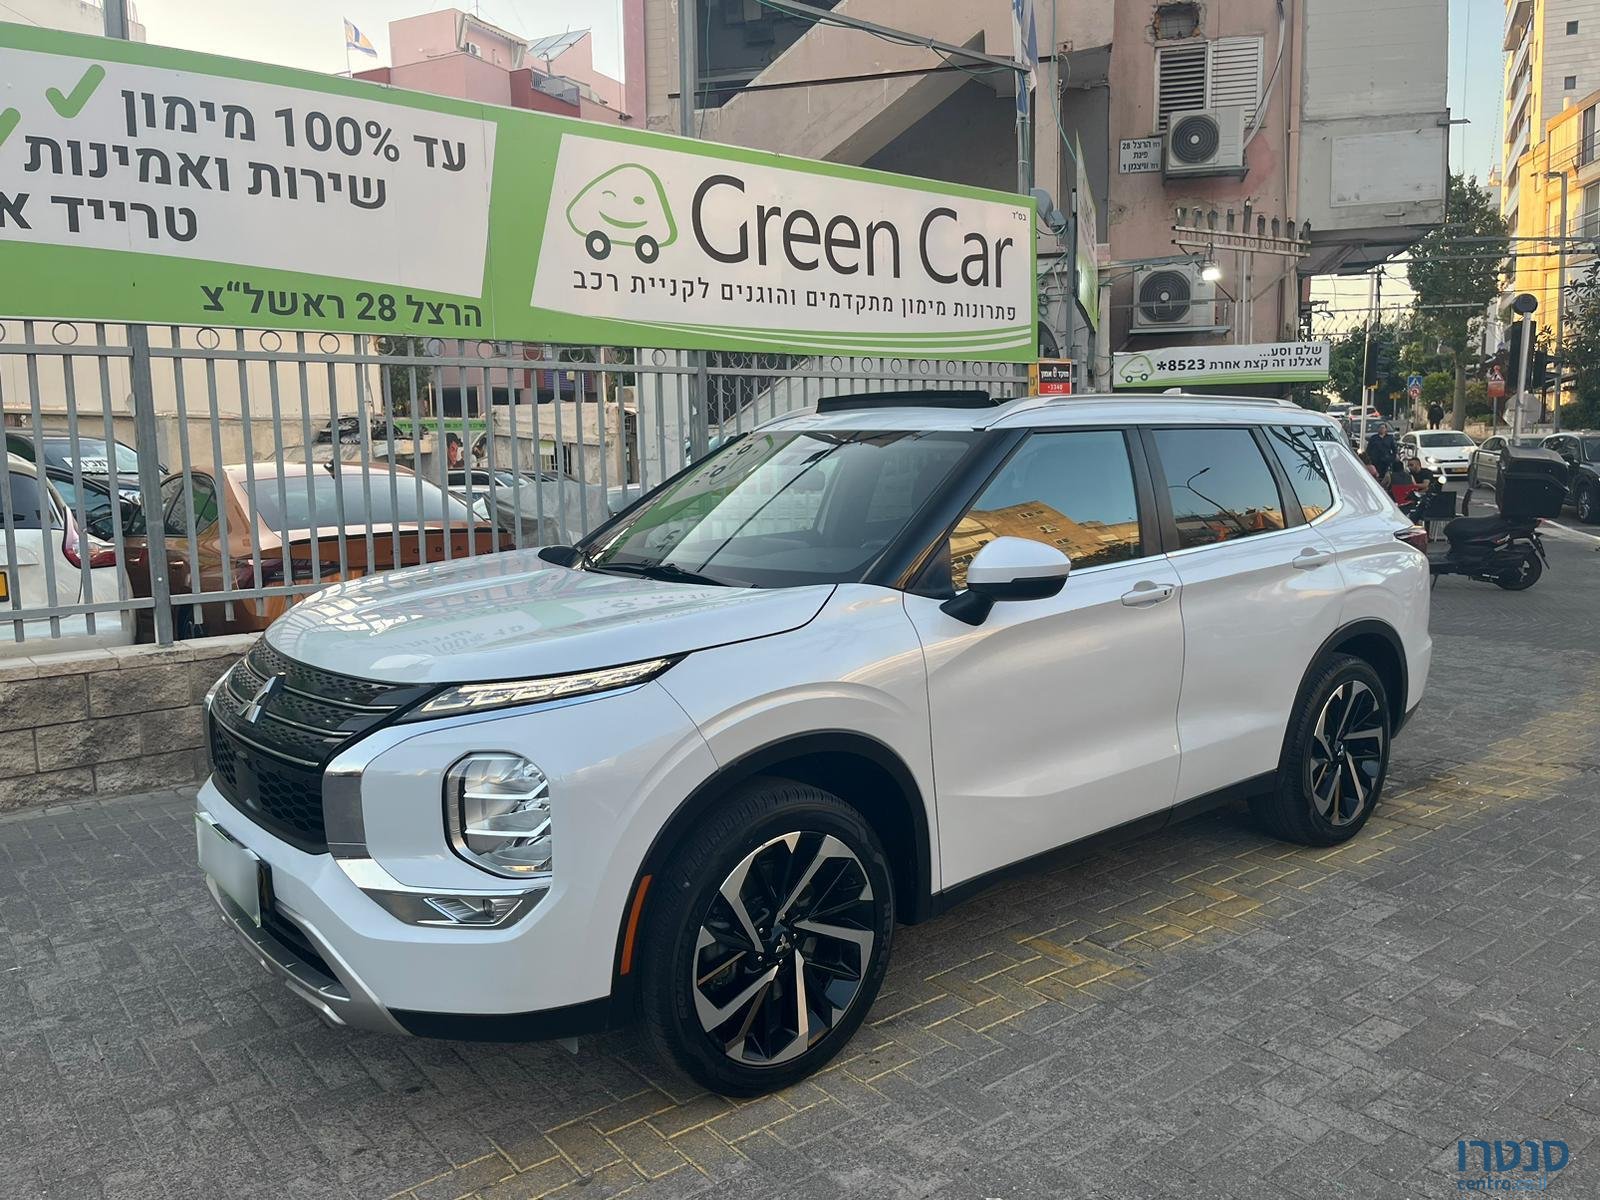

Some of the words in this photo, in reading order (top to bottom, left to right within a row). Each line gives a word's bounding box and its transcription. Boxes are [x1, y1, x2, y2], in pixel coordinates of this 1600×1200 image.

[121, 89, 256, 142] מימון
[274, 108, 400, 163] 100%
[1122, 142, 1131, 150] 28
[1132, 140, 1151, 149] הרצל
[24, 135, 230, 192] ואמינות
[414, 135, 466, 172] עד
[1133, 151, 1149, 159] פינת
[247, 161, 386, 210] שירות
[50, 195, 198, 242] טרייד
[691, 174, 901, 280] Green
[919, 207, 1014, 289] Car
[573, 271, 619, 292] רכב
[630, 275, 710, 303] לקניית
[721, 283, 796, 306] והוגנים
[806, 290, 893, 315] מתקדמים
[355, 293, 397, 322] 28
[405, 294, 482, 328] הרצל
[901, 298, 946, 318] מימון
[953, 302, 1016, 321] פתרונות
[1288, 356, 1322, 367] אצלנו
[1295, 345, 1322, 356] שלם
[1209, 360, 1241, 370] אחרת
[1243, 359, 1269, 371] קצת
[1272, 358, 1286, 368] זה
